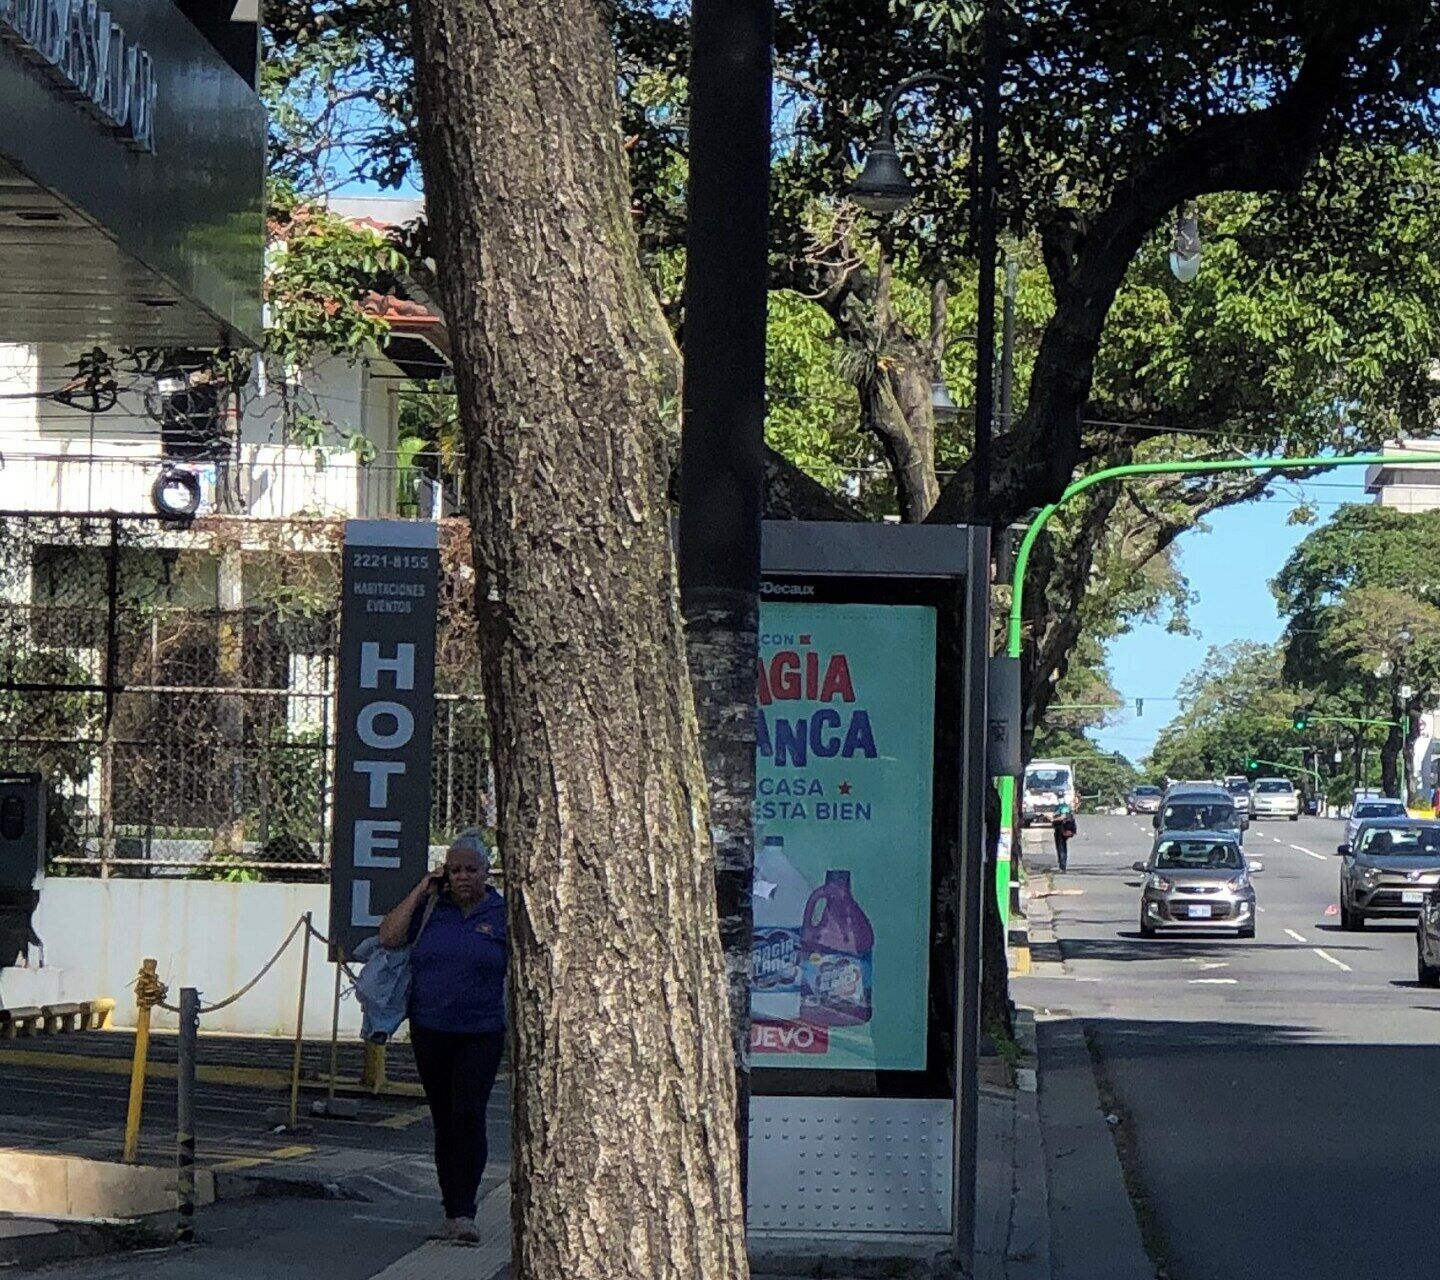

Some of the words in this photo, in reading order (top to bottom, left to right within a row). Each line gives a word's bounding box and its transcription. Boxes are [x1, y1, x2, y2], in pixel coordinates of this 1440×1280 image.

[353, 553, 429, 569] 2221-8155
[760, 581, 815, 596] Decaux
[366, 599, 412, 614] EVENTOS
[761, 634, 794, 645] CON
[351, 641, 415, 928] HOTEL
[758, 778, 824, 796] CASA
[815, 802, 872, 820] BIEN
[751, 1026, 814, 1048] UEVO
